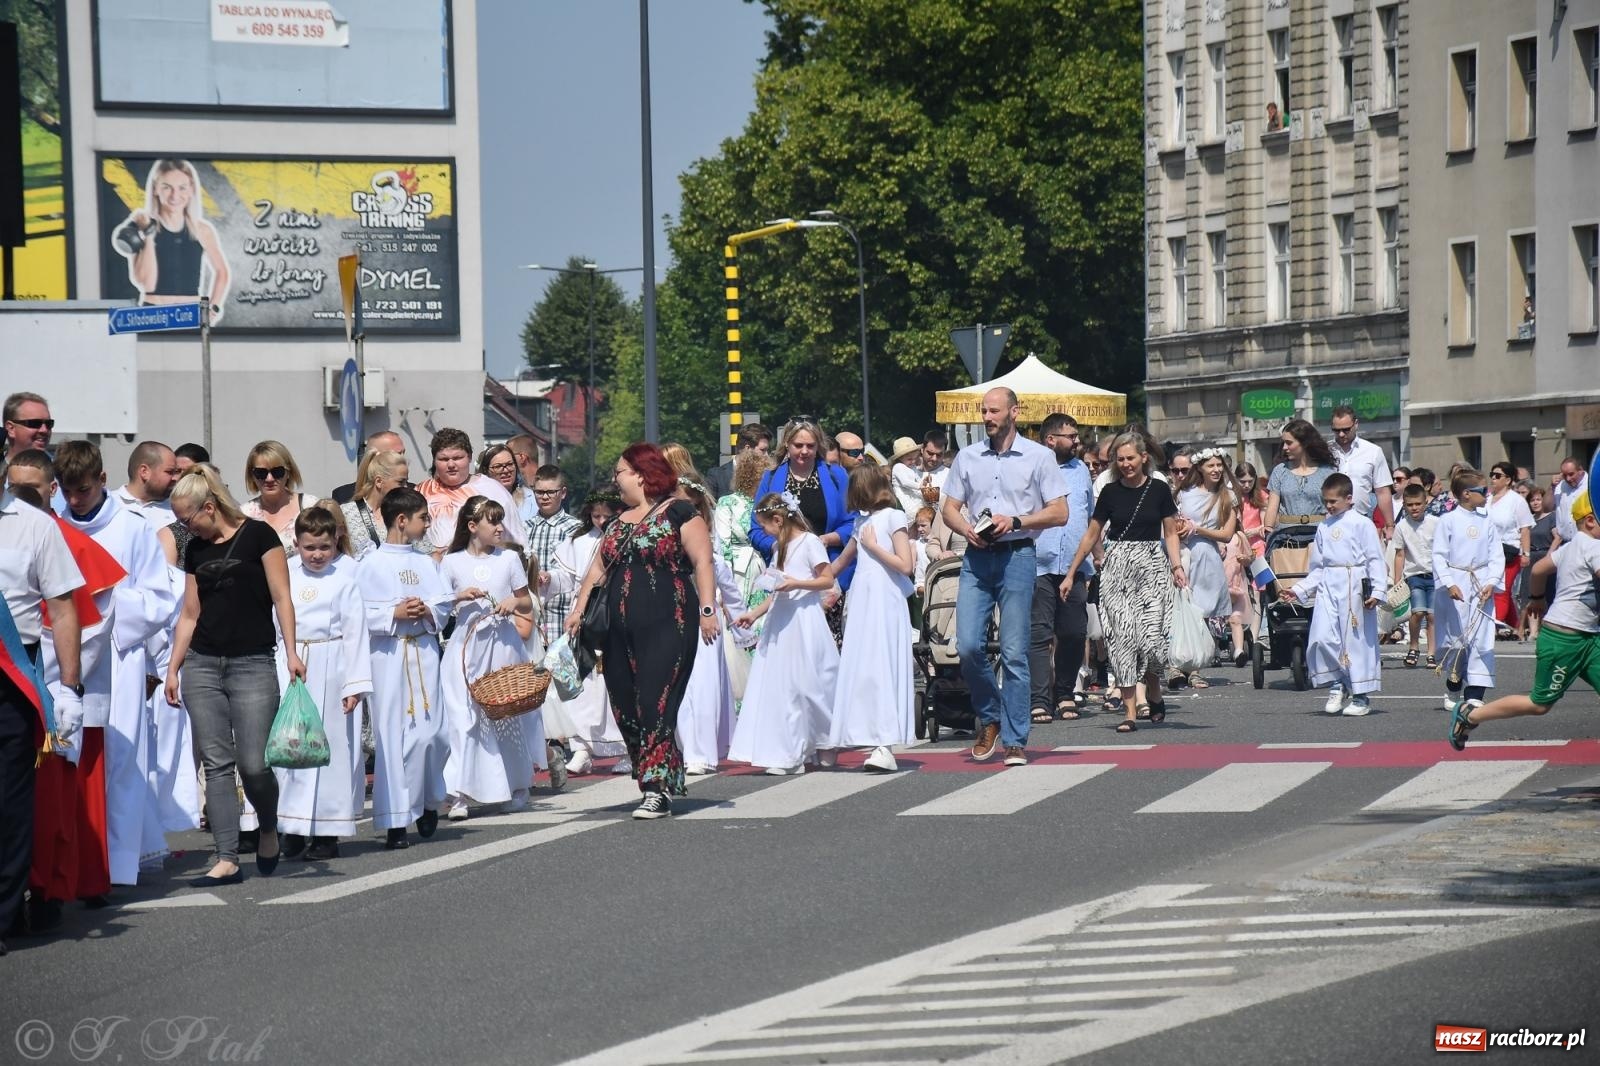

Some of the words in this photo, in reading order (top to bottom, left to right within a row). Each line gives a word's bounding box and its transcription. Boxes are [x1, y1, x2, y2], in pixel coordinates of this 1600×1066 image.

[218, 4, 261, 17] TABLICA
[264, 7, 279, 17] DO
[252, 22, 273, 36] 609
[278, 23, 299, 37] 545
[303, 24, 324, 38] 359
[254, 199, 273, 228] Z
[279, 207, 321, 229] nimi
[360, 211, 425, 228] TRENING
[244, 233, 320, 255] wrócisz
[382, 242, 398, 252] 515
[402, 242, 417, 252] 247
[421, 243, 438, 253] 002
[251, 259, 273, 282] do
[275, 259, 327, 292] formy
[361, 267, 441, 289] DYMEL
[376, 301, 397, 310] 723
[402, 301, 421, 310] 501
[426, 301, 442, 310] 191
[1250, 395, 1291, 409] żabka
